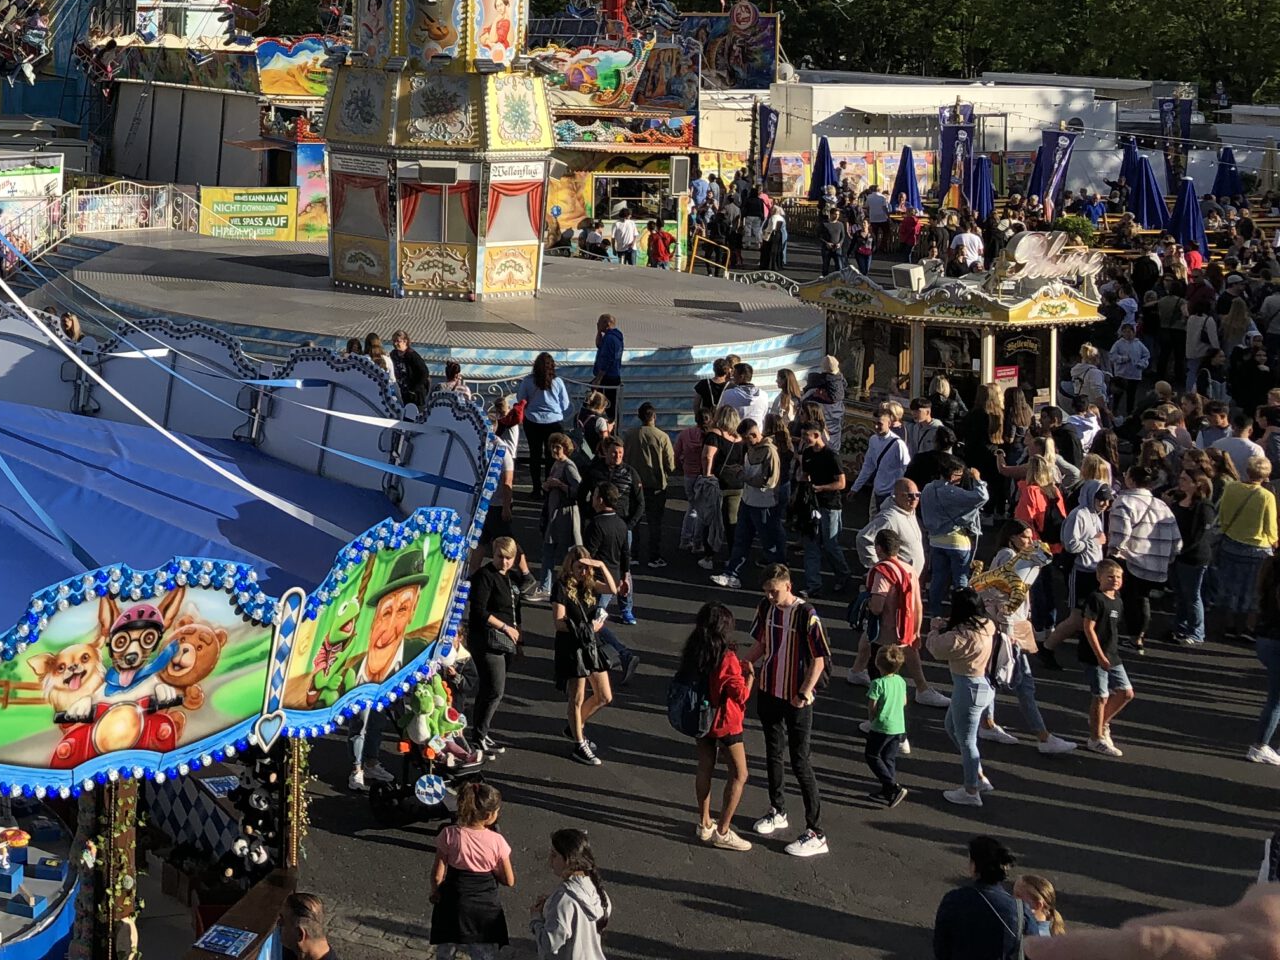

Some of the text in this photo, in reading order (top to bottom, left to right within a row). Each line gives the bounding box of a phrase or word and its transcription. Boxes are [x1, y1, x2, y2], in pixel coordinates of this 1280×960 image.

[266, 194, 288, 203] MAN
[213, 203, 240, 213] NICHT
[242, 217, 263, 227] SPASS
[264, 216, 288, 227] AUF
